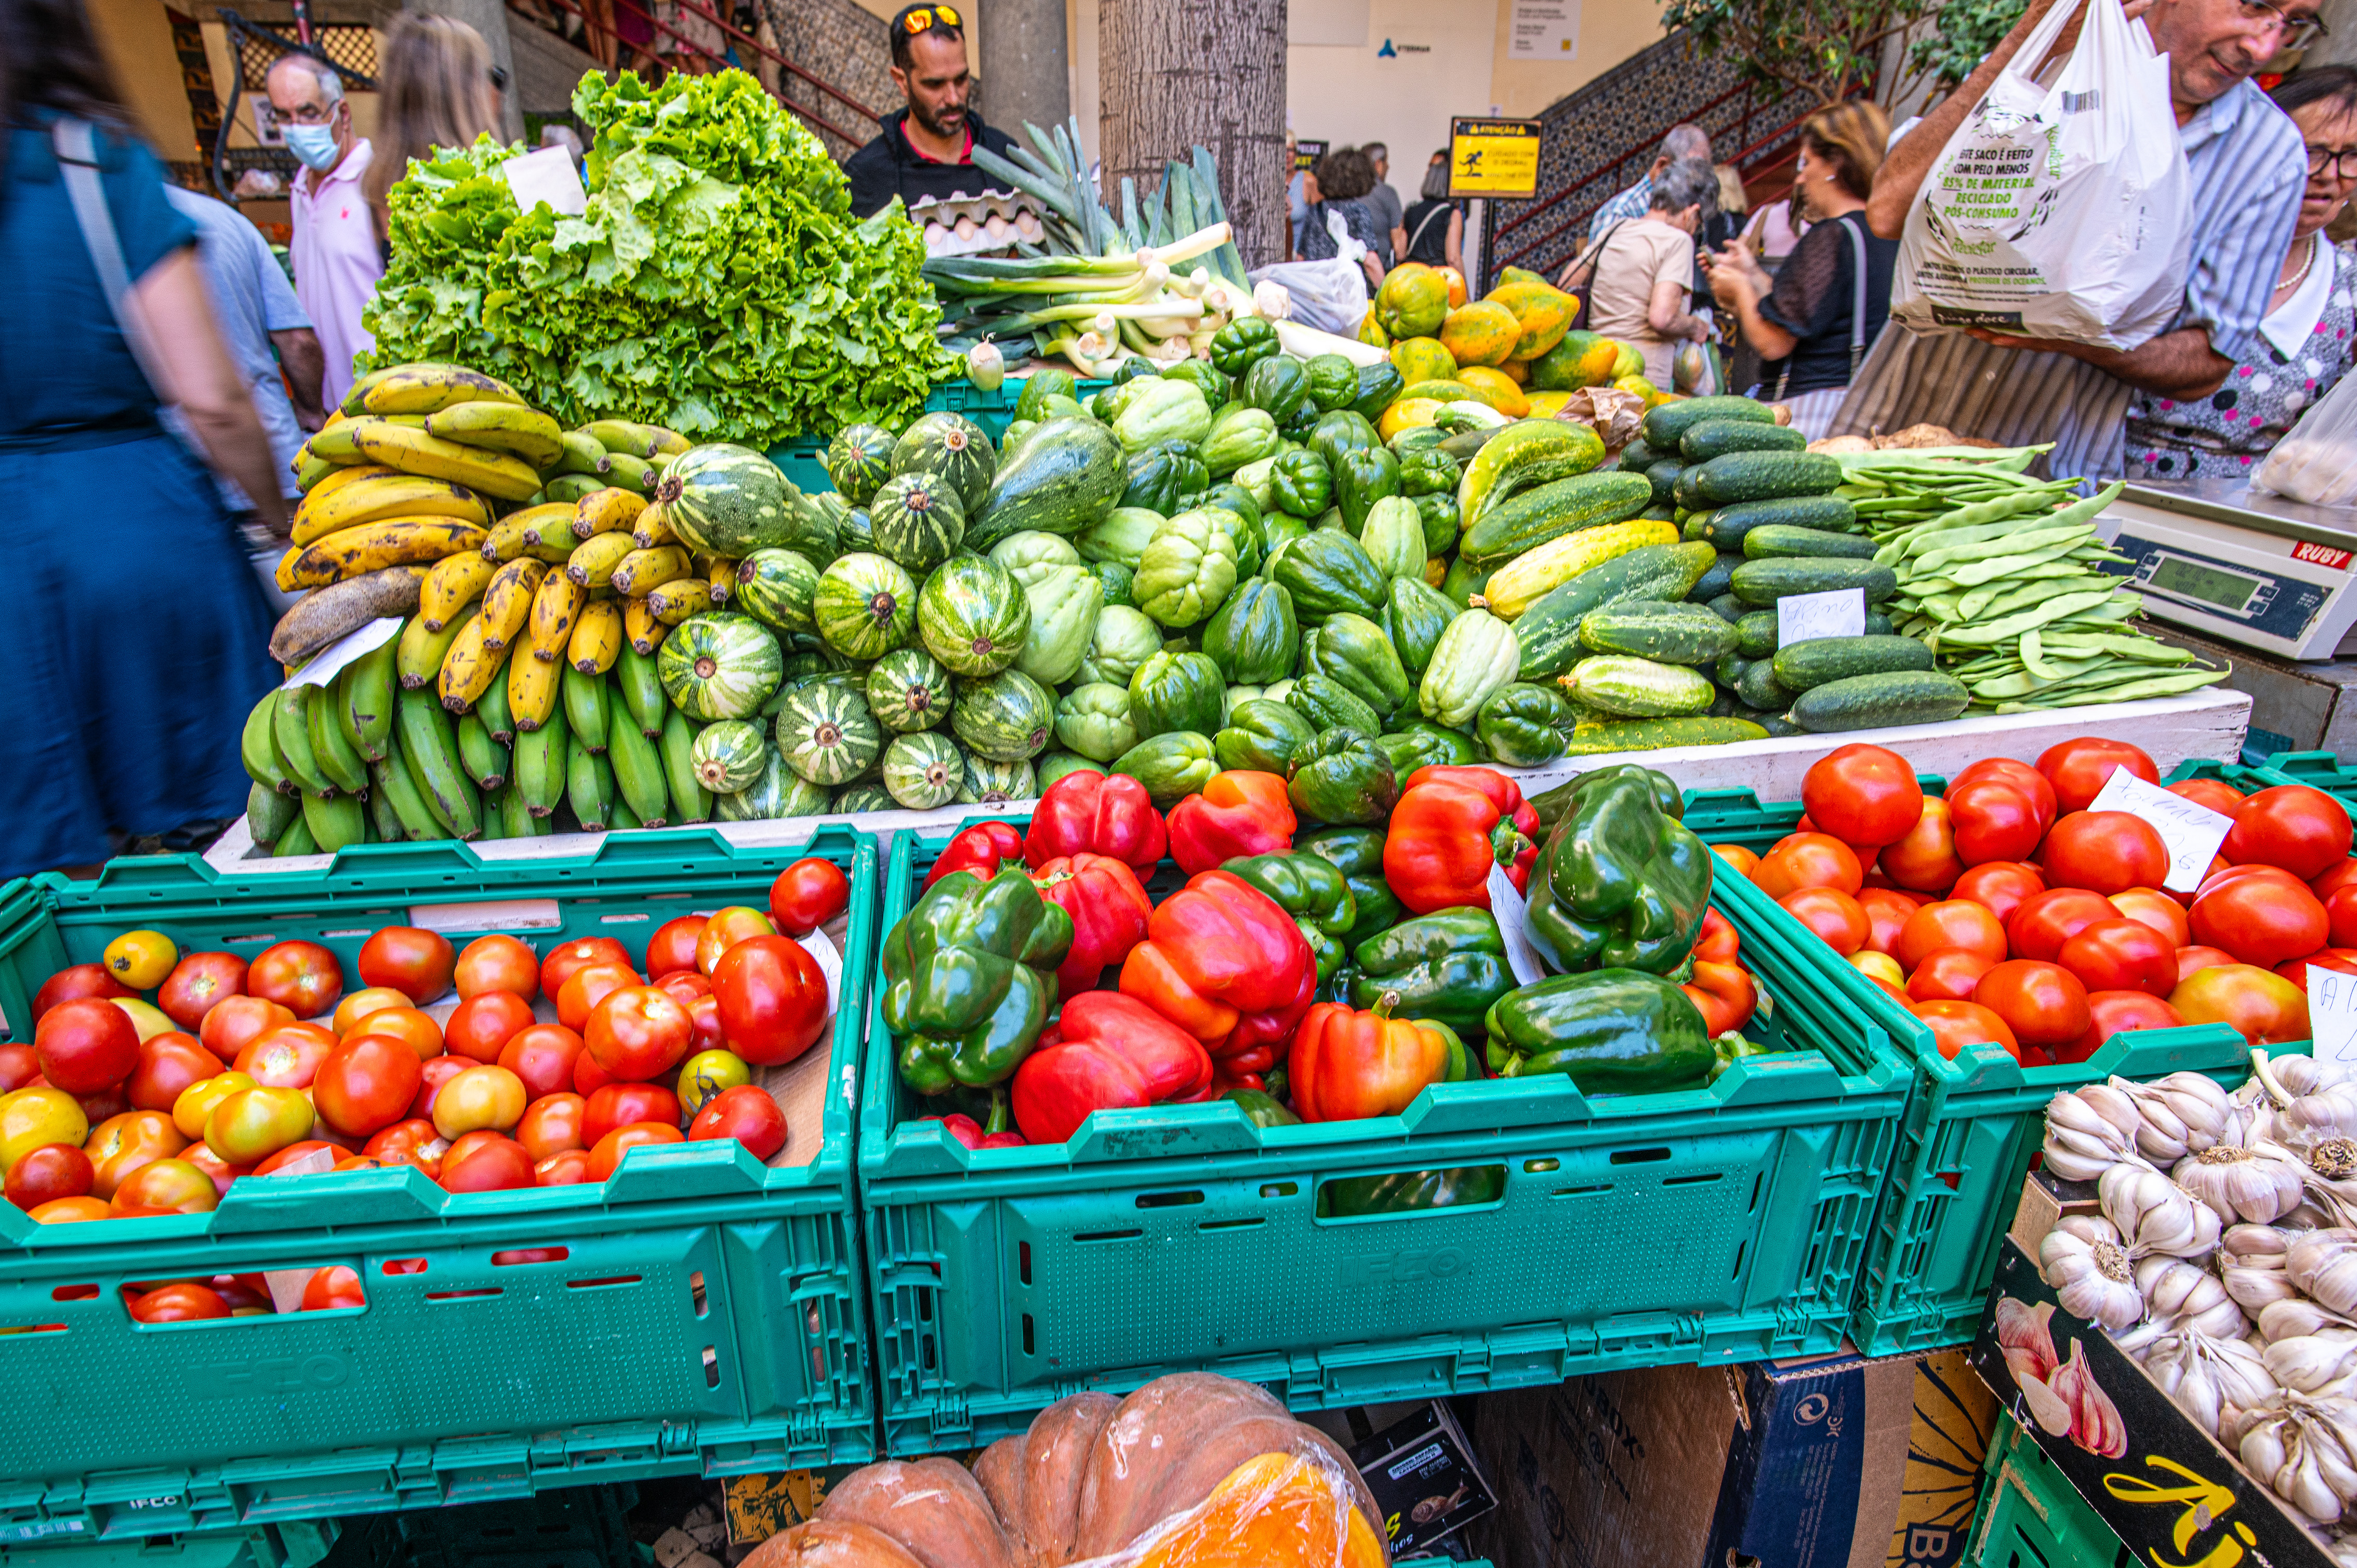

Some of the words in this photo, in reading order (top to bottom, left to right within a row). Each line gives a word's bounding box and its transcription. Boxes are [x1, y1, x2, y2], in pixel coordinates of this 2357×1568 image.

[1975, 149, 1997, 160] SACO
[2007, 149, 2034, 160] FEITO
[1954, 163, 1971, 174] COM
[1974, 164, 1993, 175] PELO
[1996, 163, 2030, 175] MENOS
[1967, 178, 1979, 189] DE
[1956, 192, 2012, 204] RECICLADO
[2297, 542, 2347, 567] RUBY
[130, 1496, 177, 1509] IFCO
